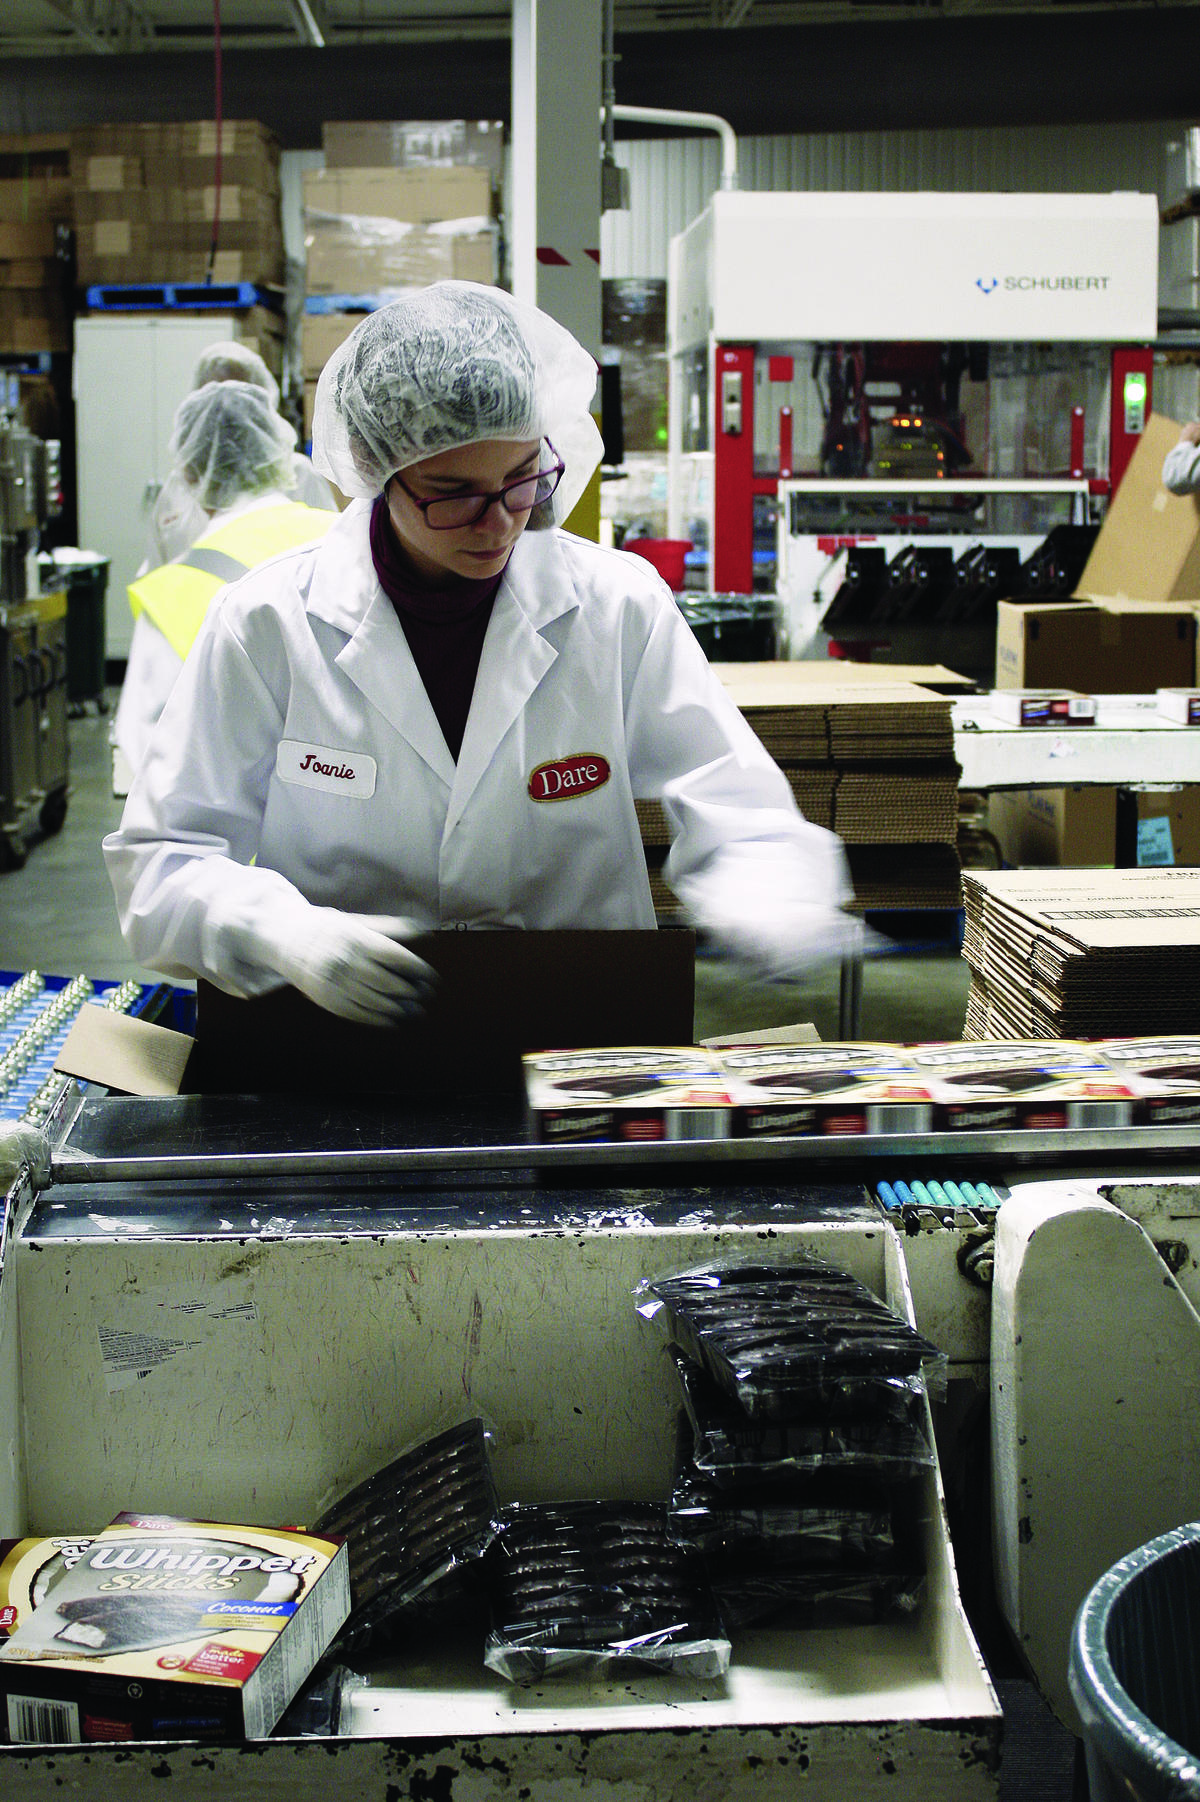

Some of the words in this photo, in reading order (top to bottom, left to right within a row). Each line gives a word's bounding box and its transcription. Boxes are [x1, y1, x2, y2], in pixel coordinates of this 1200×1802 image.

[1003, 276, 1109, 291] SCHUBERT
[300, 754, 355, 779] Joanie
[539, 764, 599, 795] Dare
[135, 1520, 171, 1530] Dare
[90, 1549, 317, 1577] Whippet
[99, 1573, 241, 1591] Sticks
[207, 1602, 283, 1614] Coconut
[208, 1648, 245, 1657] made
